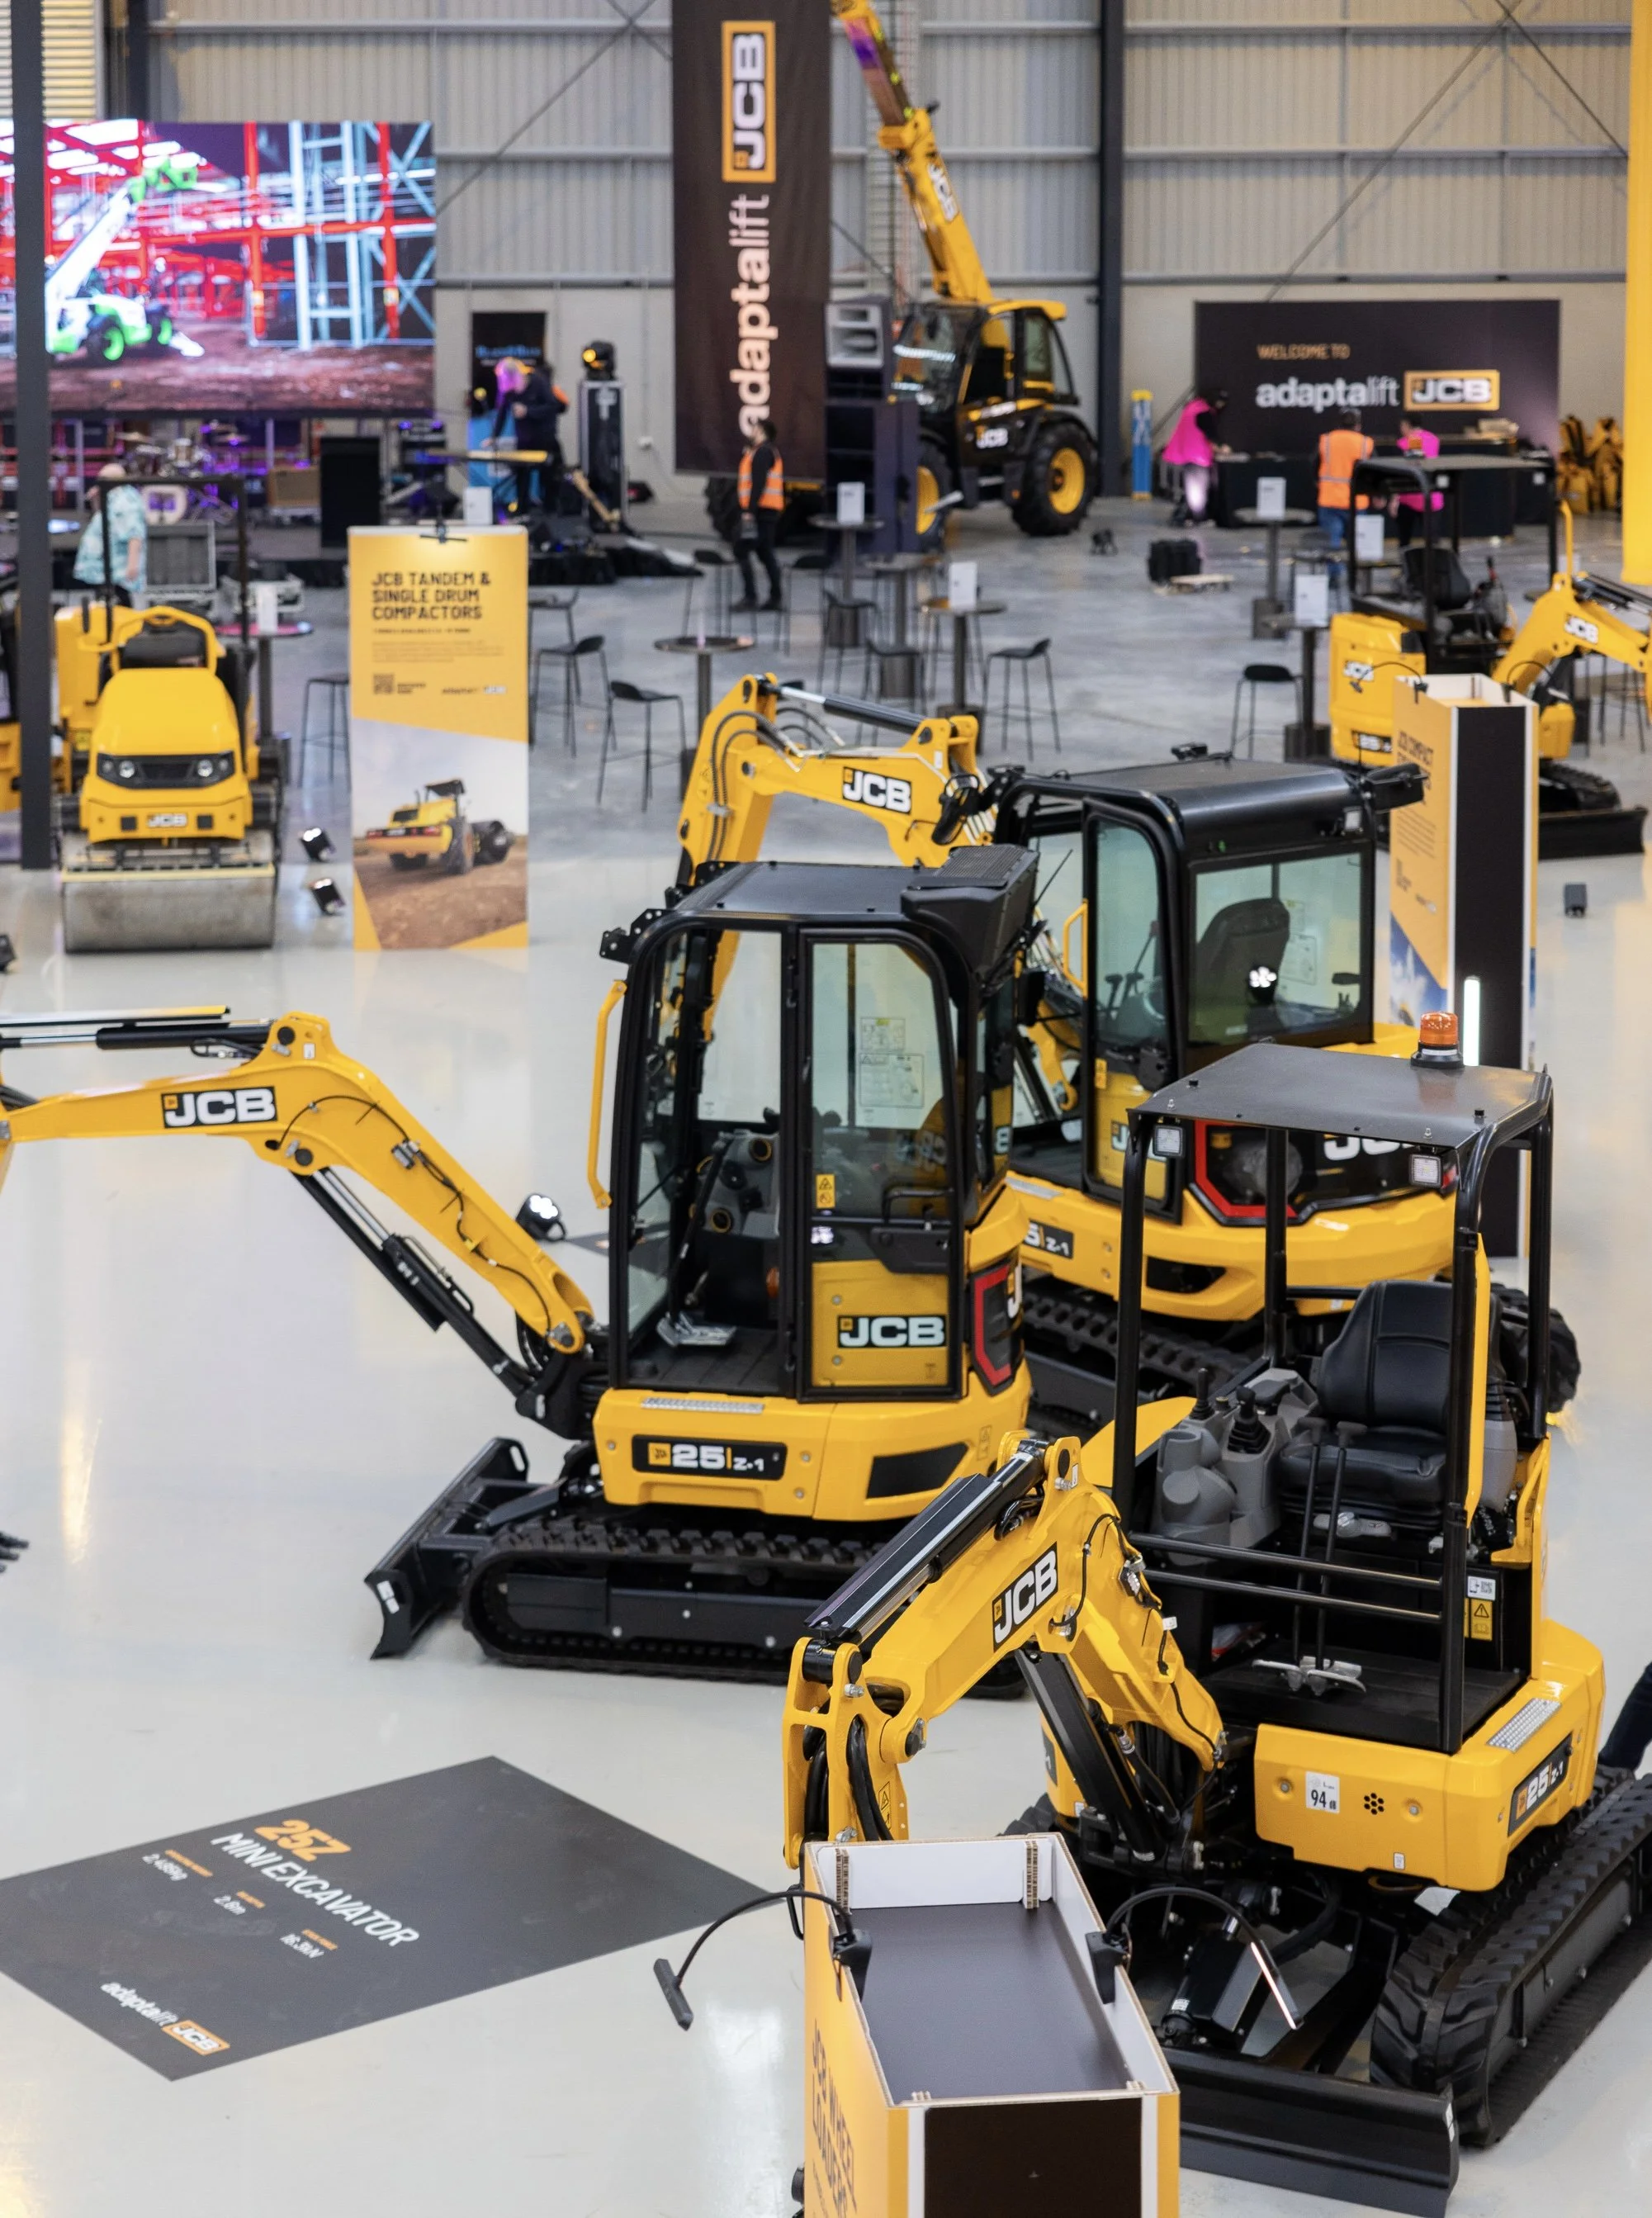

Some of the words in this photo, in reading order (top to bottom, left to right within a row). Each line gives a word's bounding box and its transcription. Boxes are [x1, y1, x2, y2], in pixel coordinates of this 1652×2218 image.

[732, 34, 766, 170] JCB
[927, 164, 958, 222] JCB
[729, 193, 779, 438] adaptalift
[1256, 344, 1328, 360] WELCOME
[1330, 343, 1351, 359] TO
[1256, 376, 1401, 413] adaptalift
[1412, 377, 1492, 403] JCB
[976, 428, 1009, 449] JCB
[373, 571, 403, 586] JCB
[409, 571, 475, 585] TANDEM
[480, 571, 491, 585] &
[373, 590, 428, 604] SINGLE
[435, 590, 480, 603] DRUM
[372, 606, 482, 620] COMPACTORS
[1564, 617, 1599, 644] JCB
[843, 770, 911, 813] JCB
[164, 1088, 276, 1128] JCB
[839, 1316, 945, 1348] JCB
[671, 1443, 726, 1470] 25
[994, 1550, 1057, 1644] JCB
[1310, 1789, 1326, 1808] 94
[1526, 1765, 1550, 1810] 25
[253, 1819, 352, 1862] 25Z
[211, 1832, 284, 1868] MINI
[260, 1861, 419, 1947] EXCAVATOR
[100, 1982, 178, 2027] adaptalift
[172, 2026, 220, 2050] JCB
[828, 2065, 857, 2215] WHEEL
